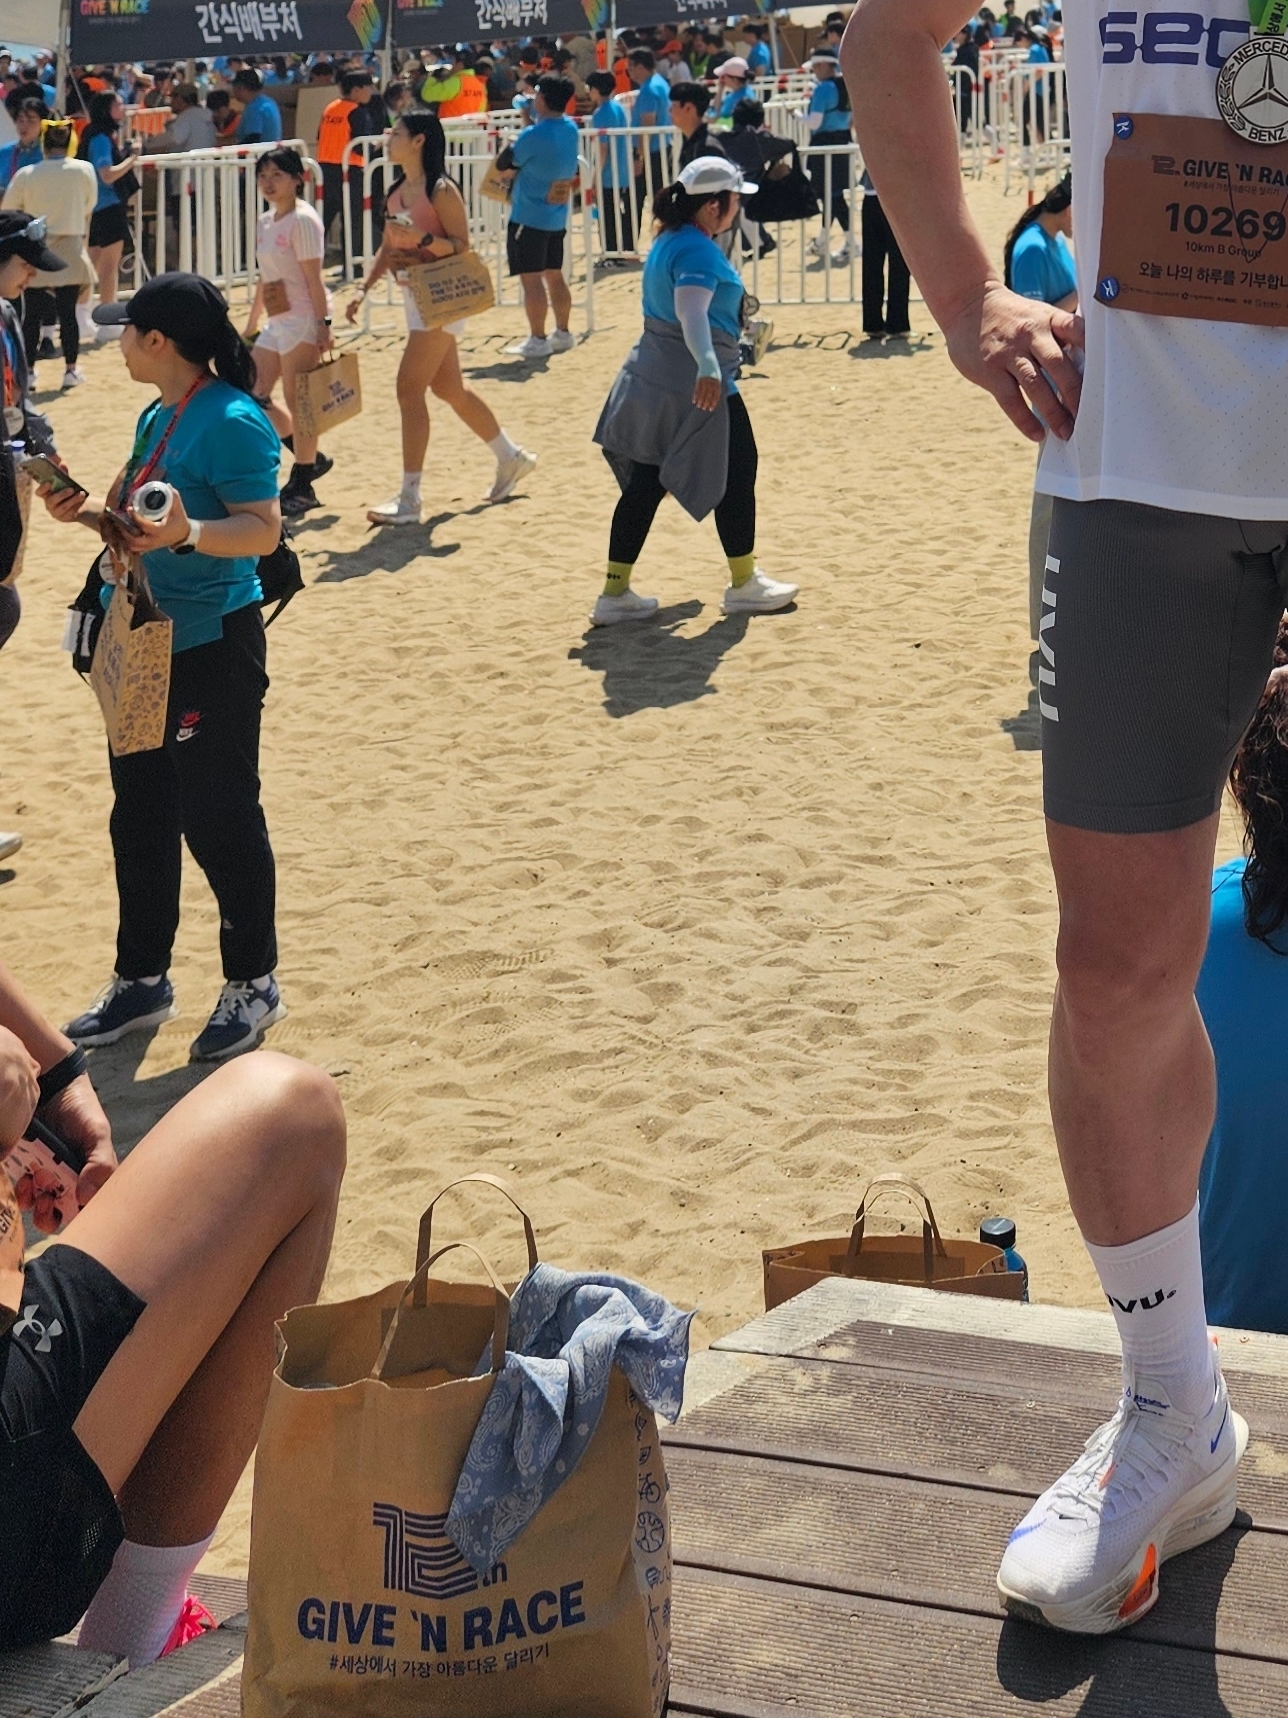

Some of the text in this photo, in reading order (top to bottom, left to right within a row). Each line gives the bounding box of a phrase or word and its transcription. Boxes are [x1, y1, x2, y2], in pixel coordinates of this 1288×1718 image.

[195, 0, 303, 43] 간식배부처
[1248, 127, 1288, 142] BENZ
[1183, 159, 1229, 180] GIVE
[1165, 202, 1287, 241] 10269
[1185, 241, 1262, 258] 10km B Group
[1139, 262, 1163, 279] 오늘
[1167, 265, 1193, 282] 나의
[1197, 267, 1236, 286] 하루를
[297, 1580, 587, 1653] GIVE 'N RACE
[329, 1641, 551, 1679] #세상에서 가장 아름다운 달리기
